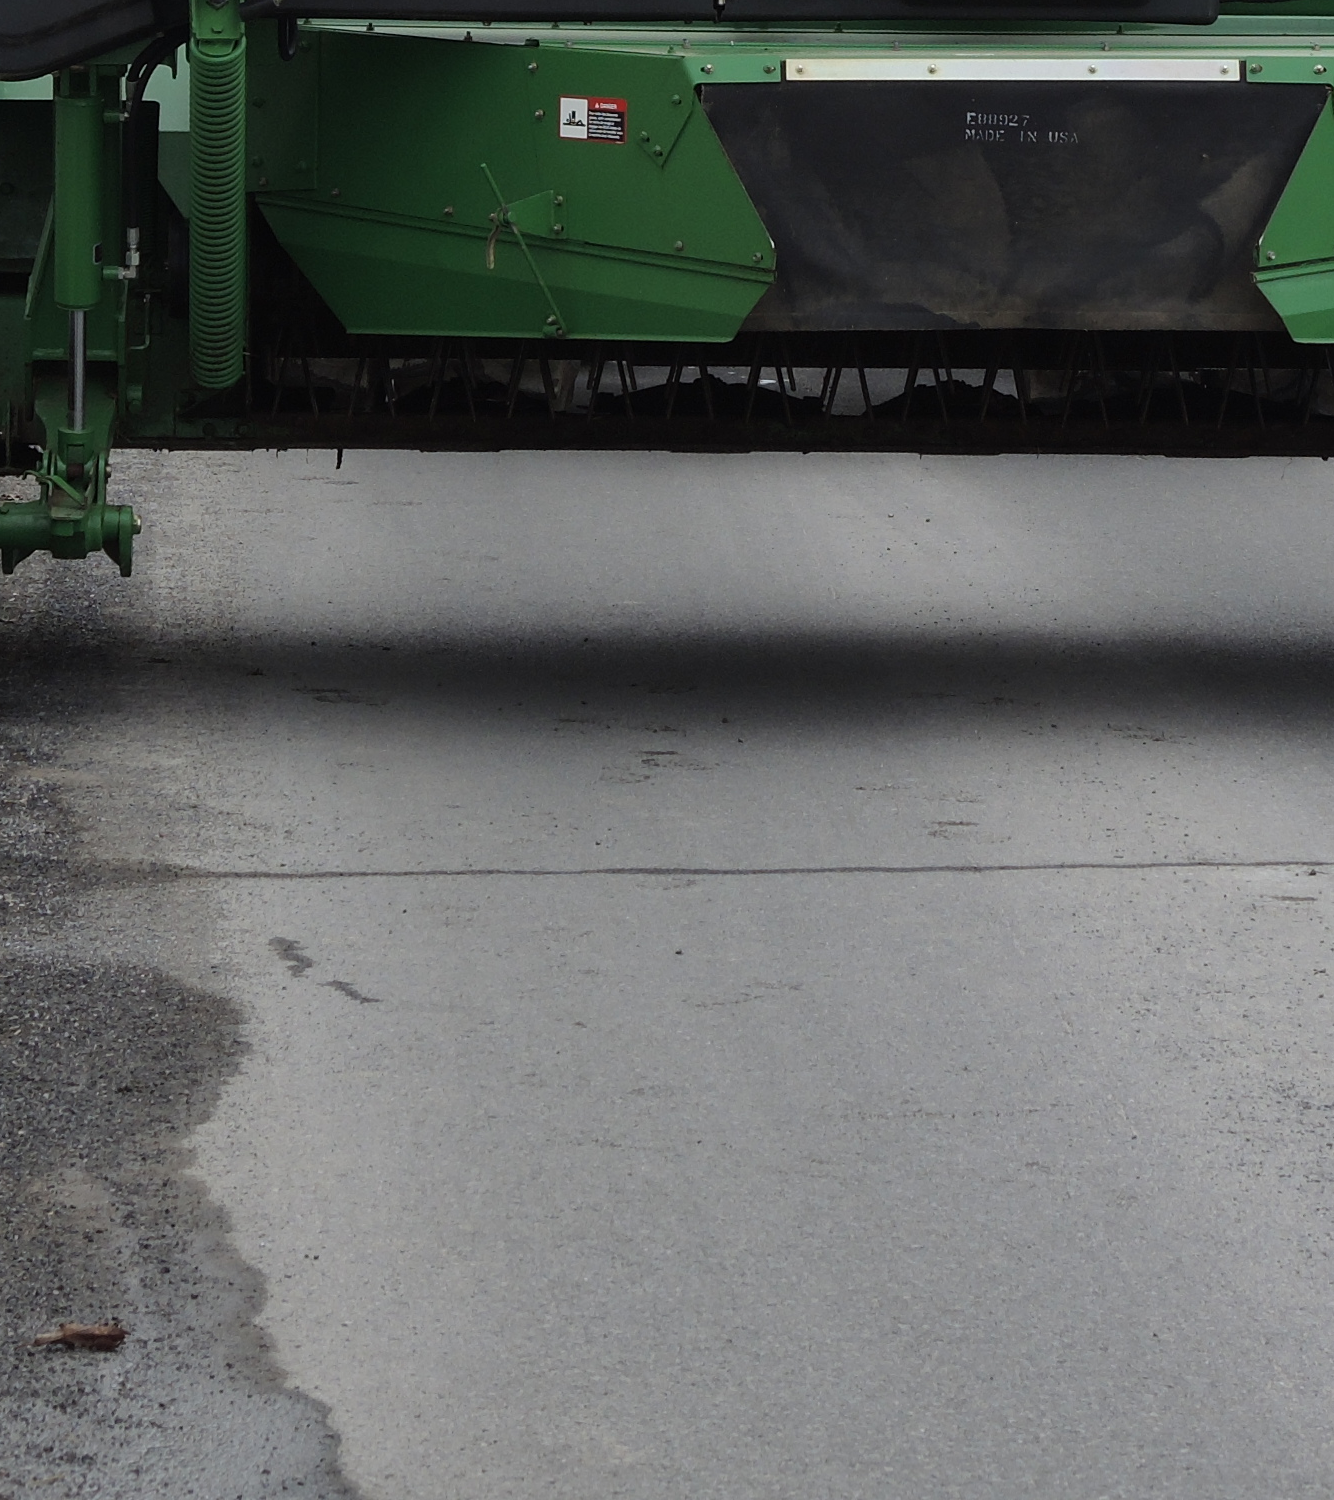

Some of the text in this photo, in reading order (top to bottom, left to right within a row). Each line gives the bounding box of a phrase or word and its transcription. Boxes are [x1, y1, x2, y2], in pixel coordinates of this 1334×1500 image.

[966, 111, 1030, 127] E88927
[965, 128, 1079, 144] MADE IN USA
